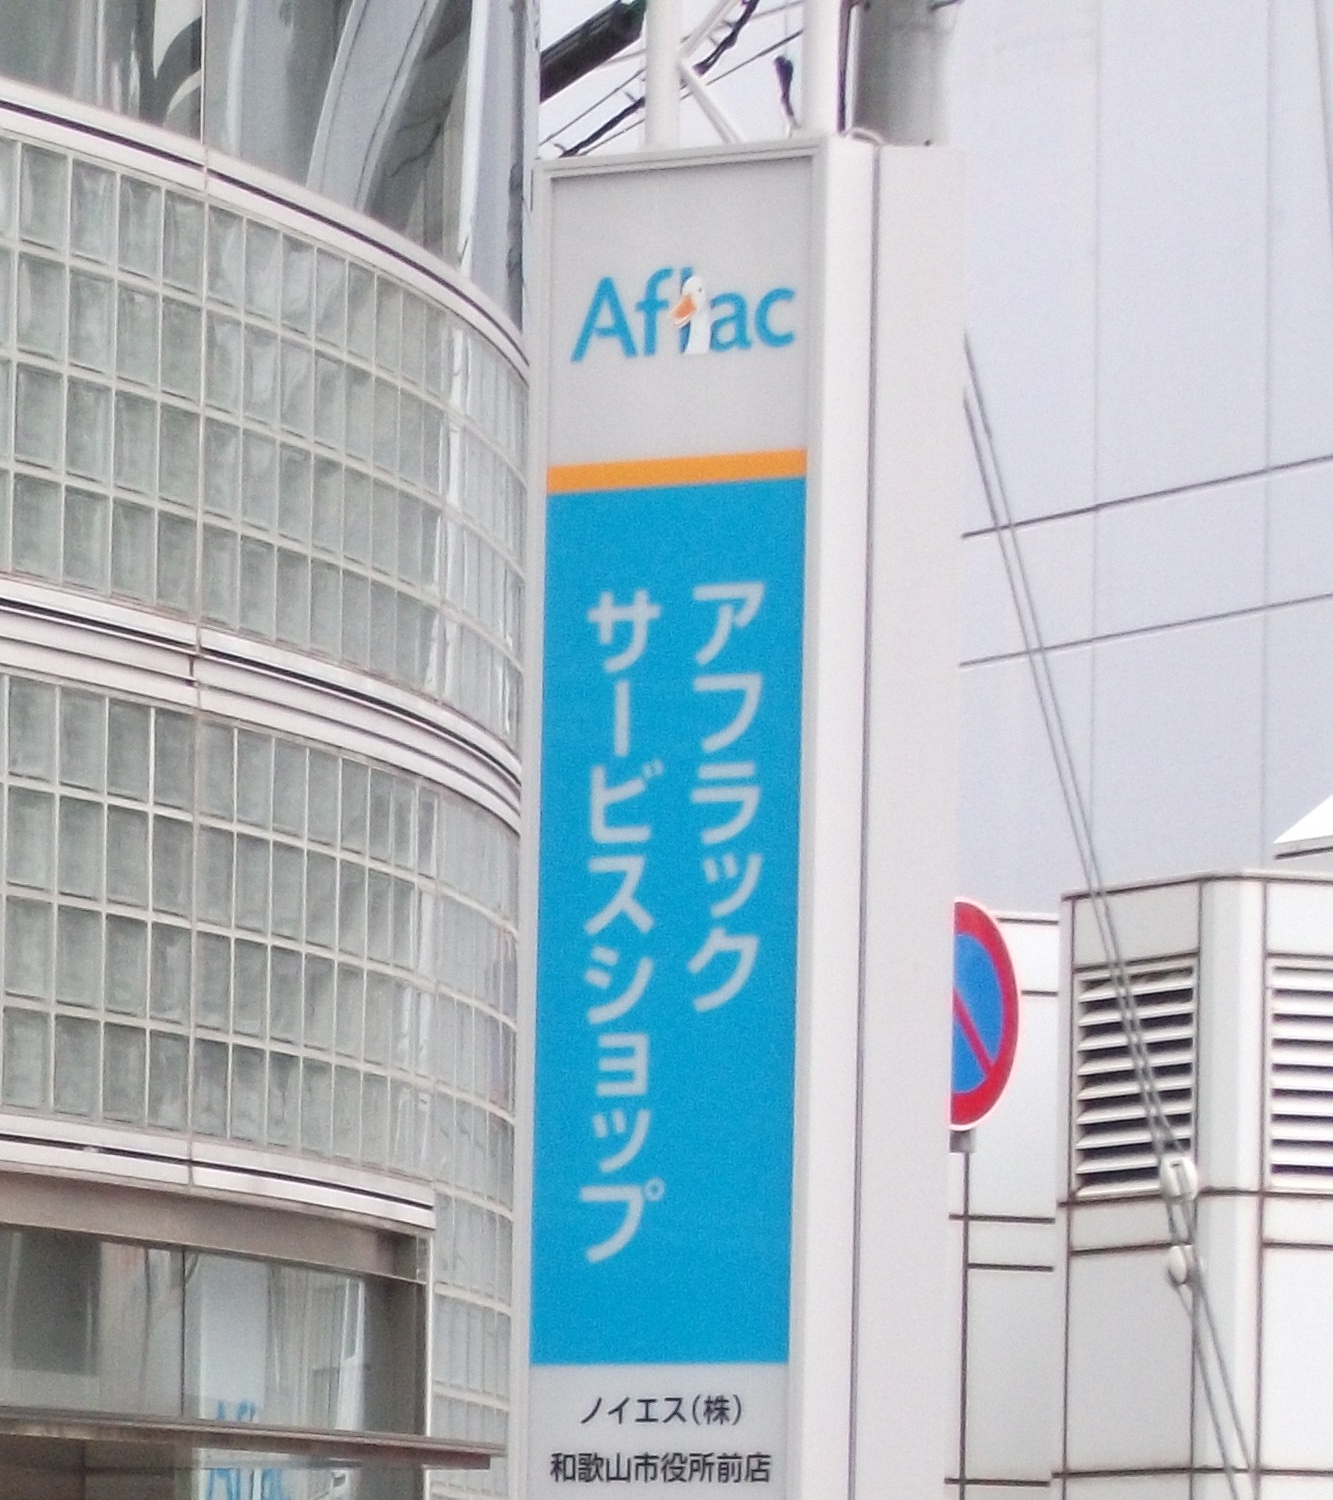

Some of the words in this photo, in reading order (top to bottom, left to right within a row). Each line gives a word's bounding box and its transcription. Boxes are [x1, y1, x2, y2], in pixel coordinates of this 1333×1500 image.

[580, 589, 665, 1263] サービスショップ
[689, 582, 766, 1012] アフラック
[549, 1451, 772, 1485] 和歌山市役所前店
